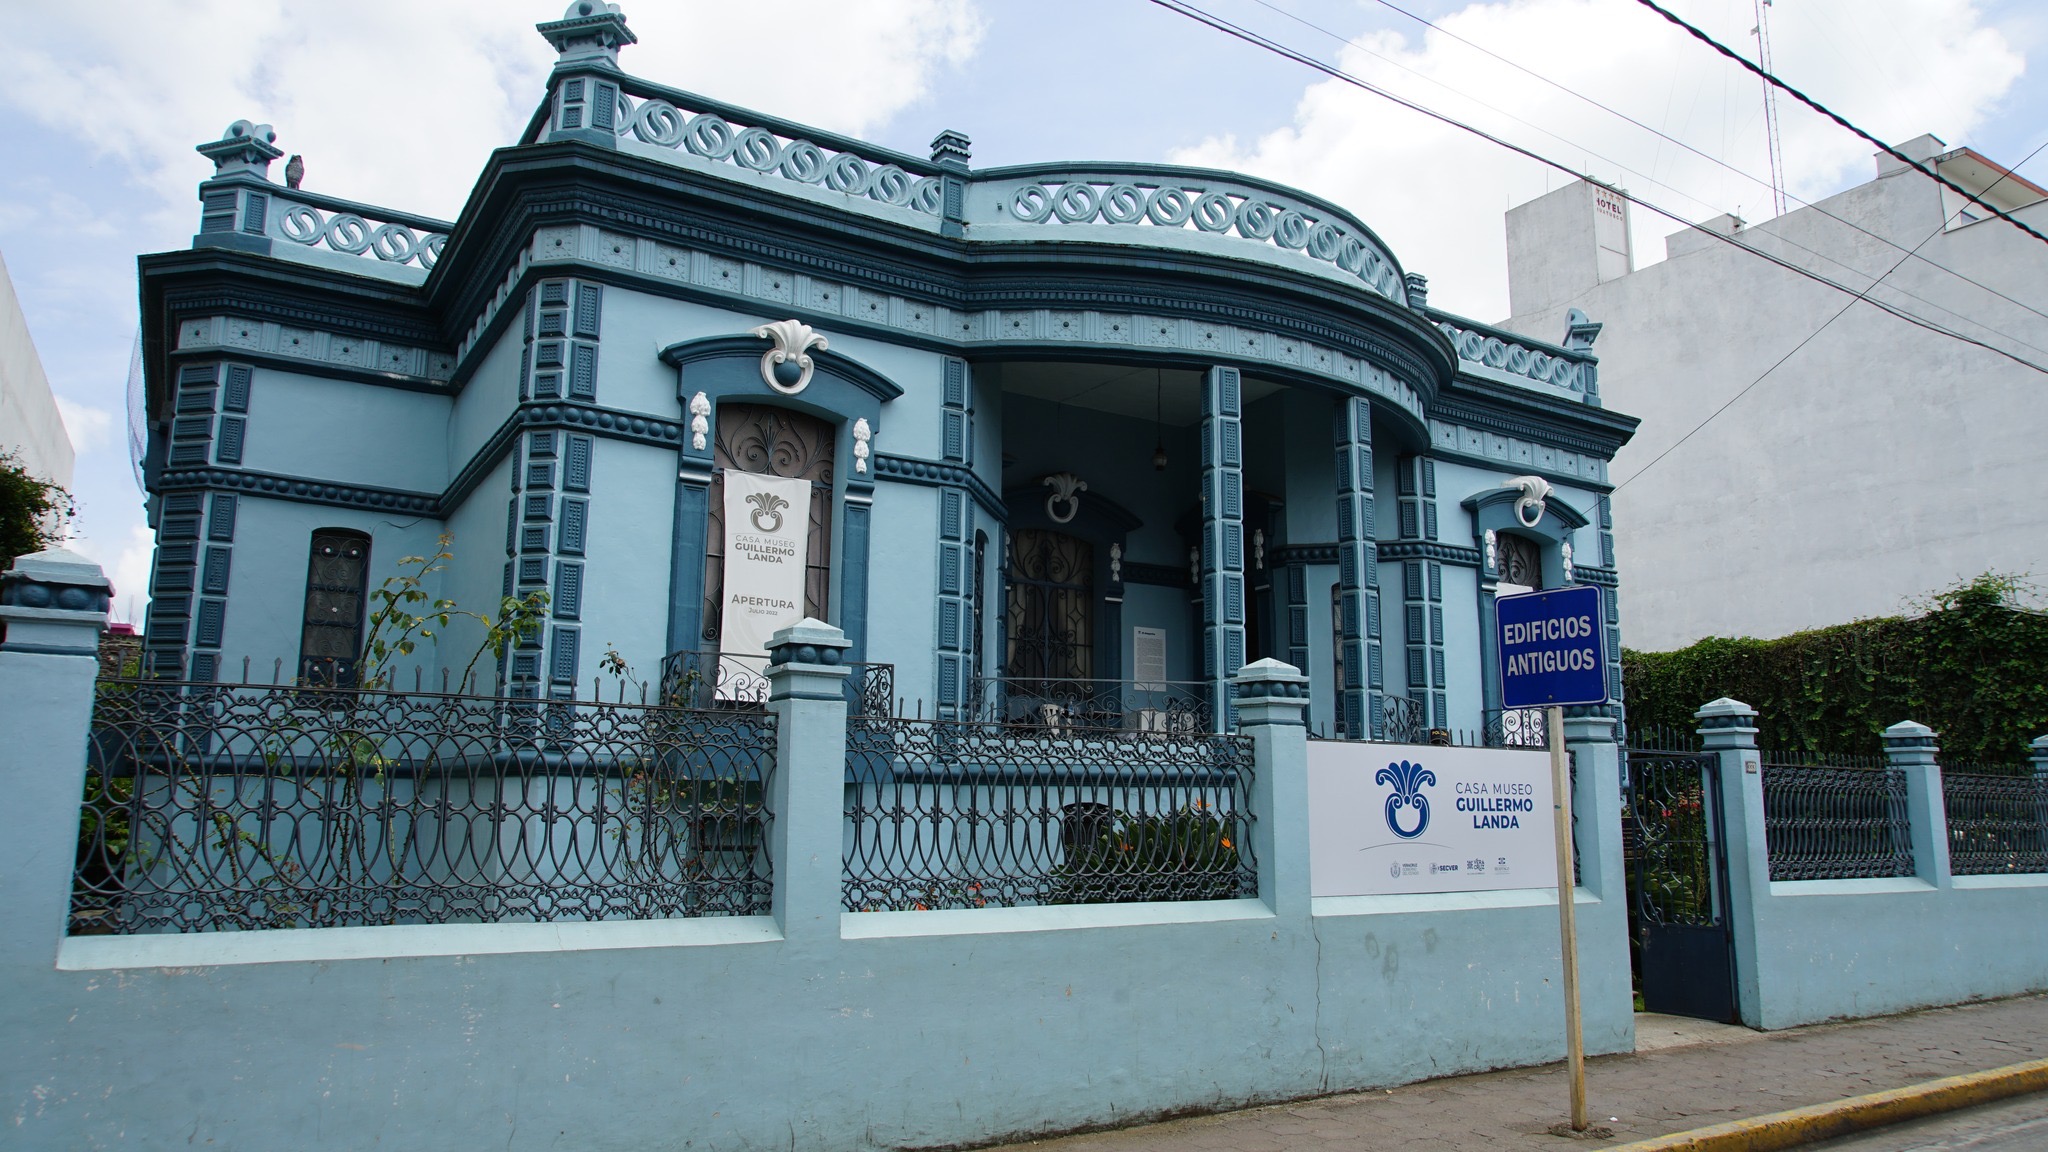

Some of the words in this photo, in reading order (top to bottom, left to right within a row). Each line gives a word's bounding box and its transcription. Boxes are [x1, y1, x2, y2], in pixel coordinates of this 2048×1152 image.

[735, 534, 760, 544] CASA
[764, 538, 796, 549] MUSEO
[734, 542, 795, 557] GUILLERMO
[747, 552, 783, 564] LANDA
[1503, 615, 1592, 645] EDIFICIOS
[1507, 647, 1595, 677] ANTIGUOS
[1455, 782, 1489, 795] CASA
[1492, 783, 1533, 796] MUSEO
[1456, 797, 1533, 812] GUILLERMO
[1473, 814, 1520, 829] LANDA
